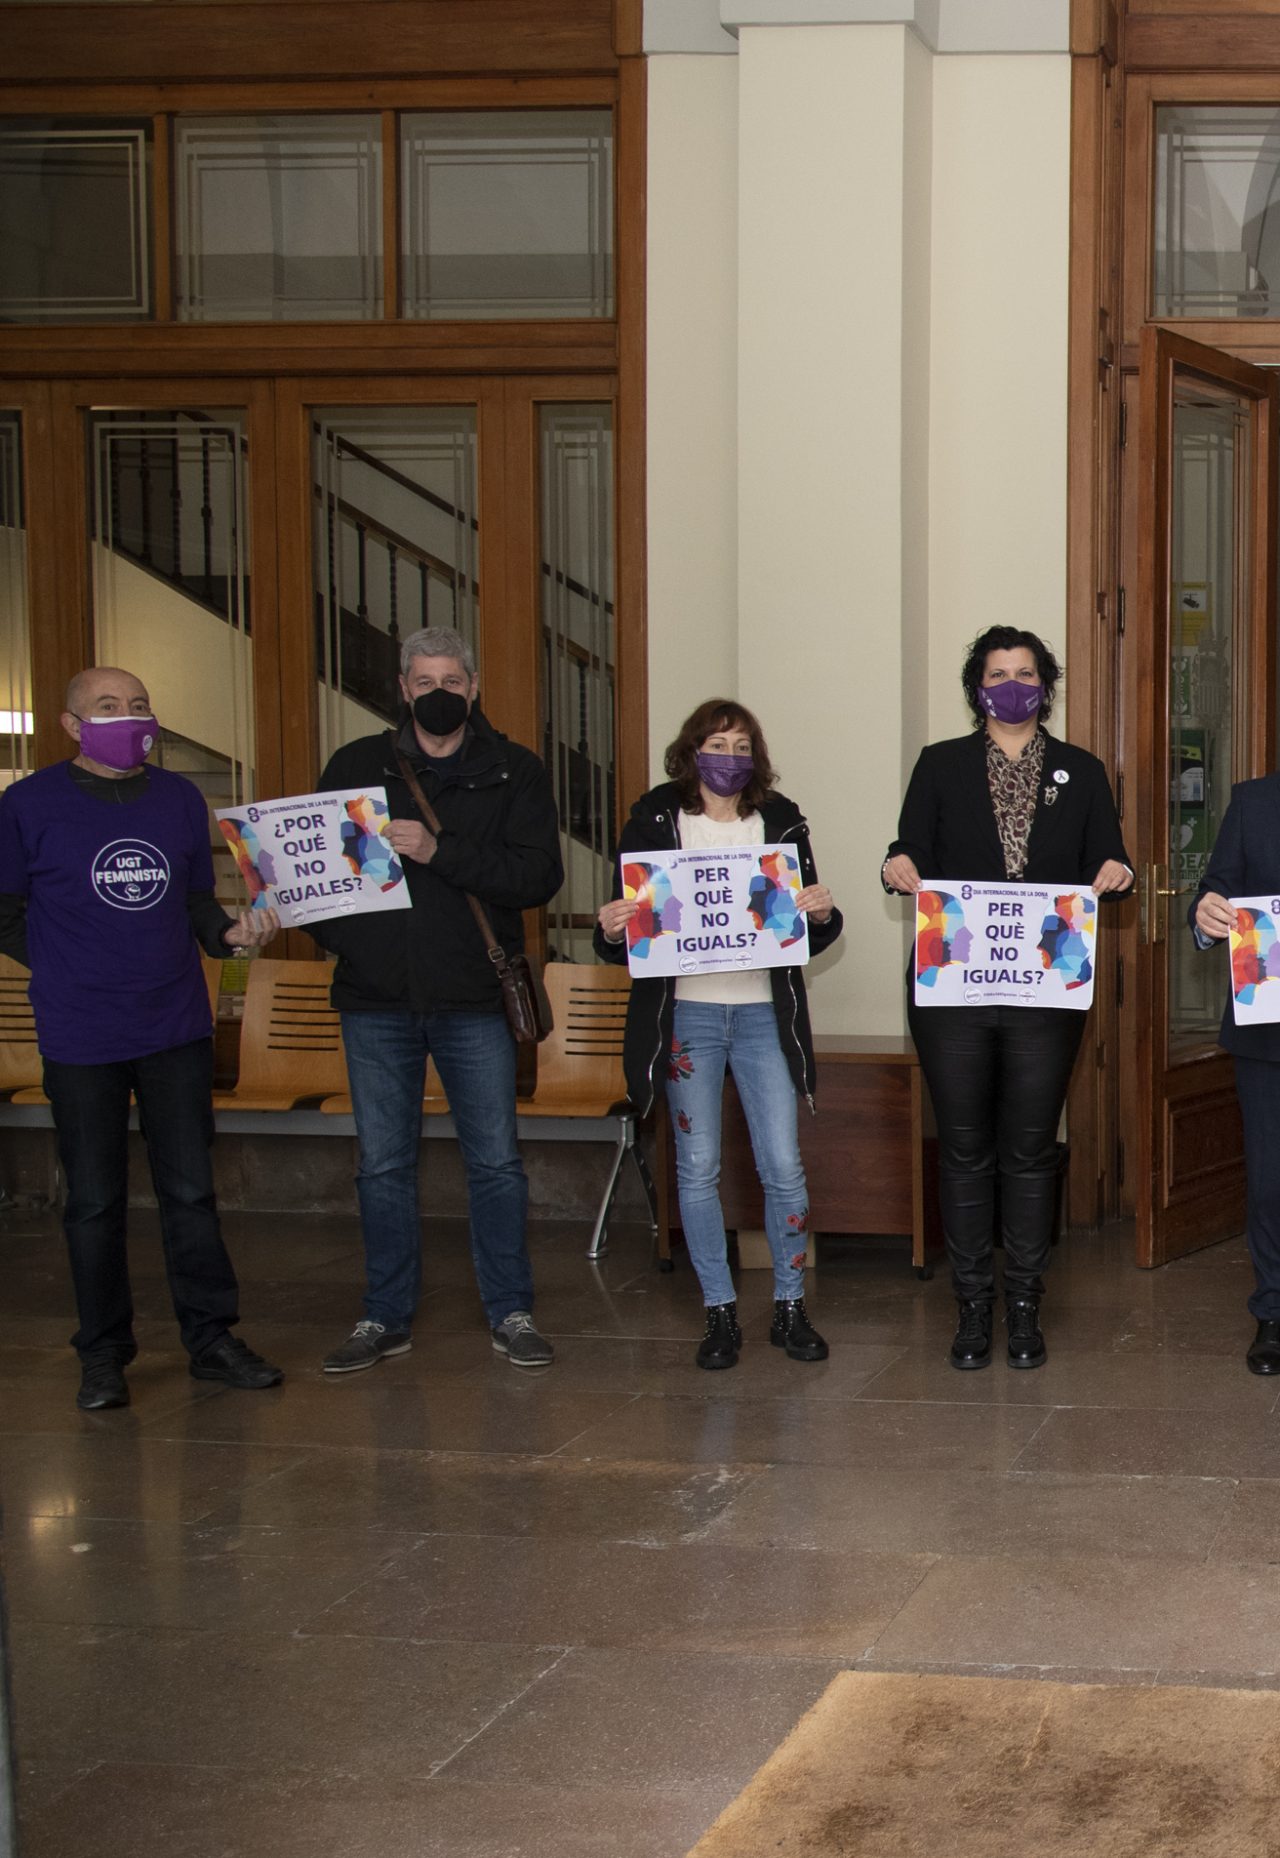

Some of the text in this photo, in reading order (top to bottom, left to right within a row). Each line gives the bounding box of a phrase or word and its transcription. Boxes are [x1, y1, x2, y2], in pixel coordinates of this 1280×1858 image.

[269, 803, 307, 814] INTERNACIONAL
[274, 813, 327, 838] ¿POR
[283, 833, 327, 857] QUÉ
[116, 856, 142, 869] UGT
[294, 860, 326, 878] NO
[96, 868, 167, 884] FEMINISTA
[694, 867, 730, 883] PER
[274, 877, 363, 905] IGUALES?
[694, 887, 734, 907] QUÈ
[988, 902, 1024, 917] PER
[701, 912, 729, 928] NO
[985, 922, 1025, 940] QUÈ
[676, 933, 758, 952] IGUALS?
[990, 947, 1018, 961] NO
[963, 969, 1044, 984] IGUALS?
